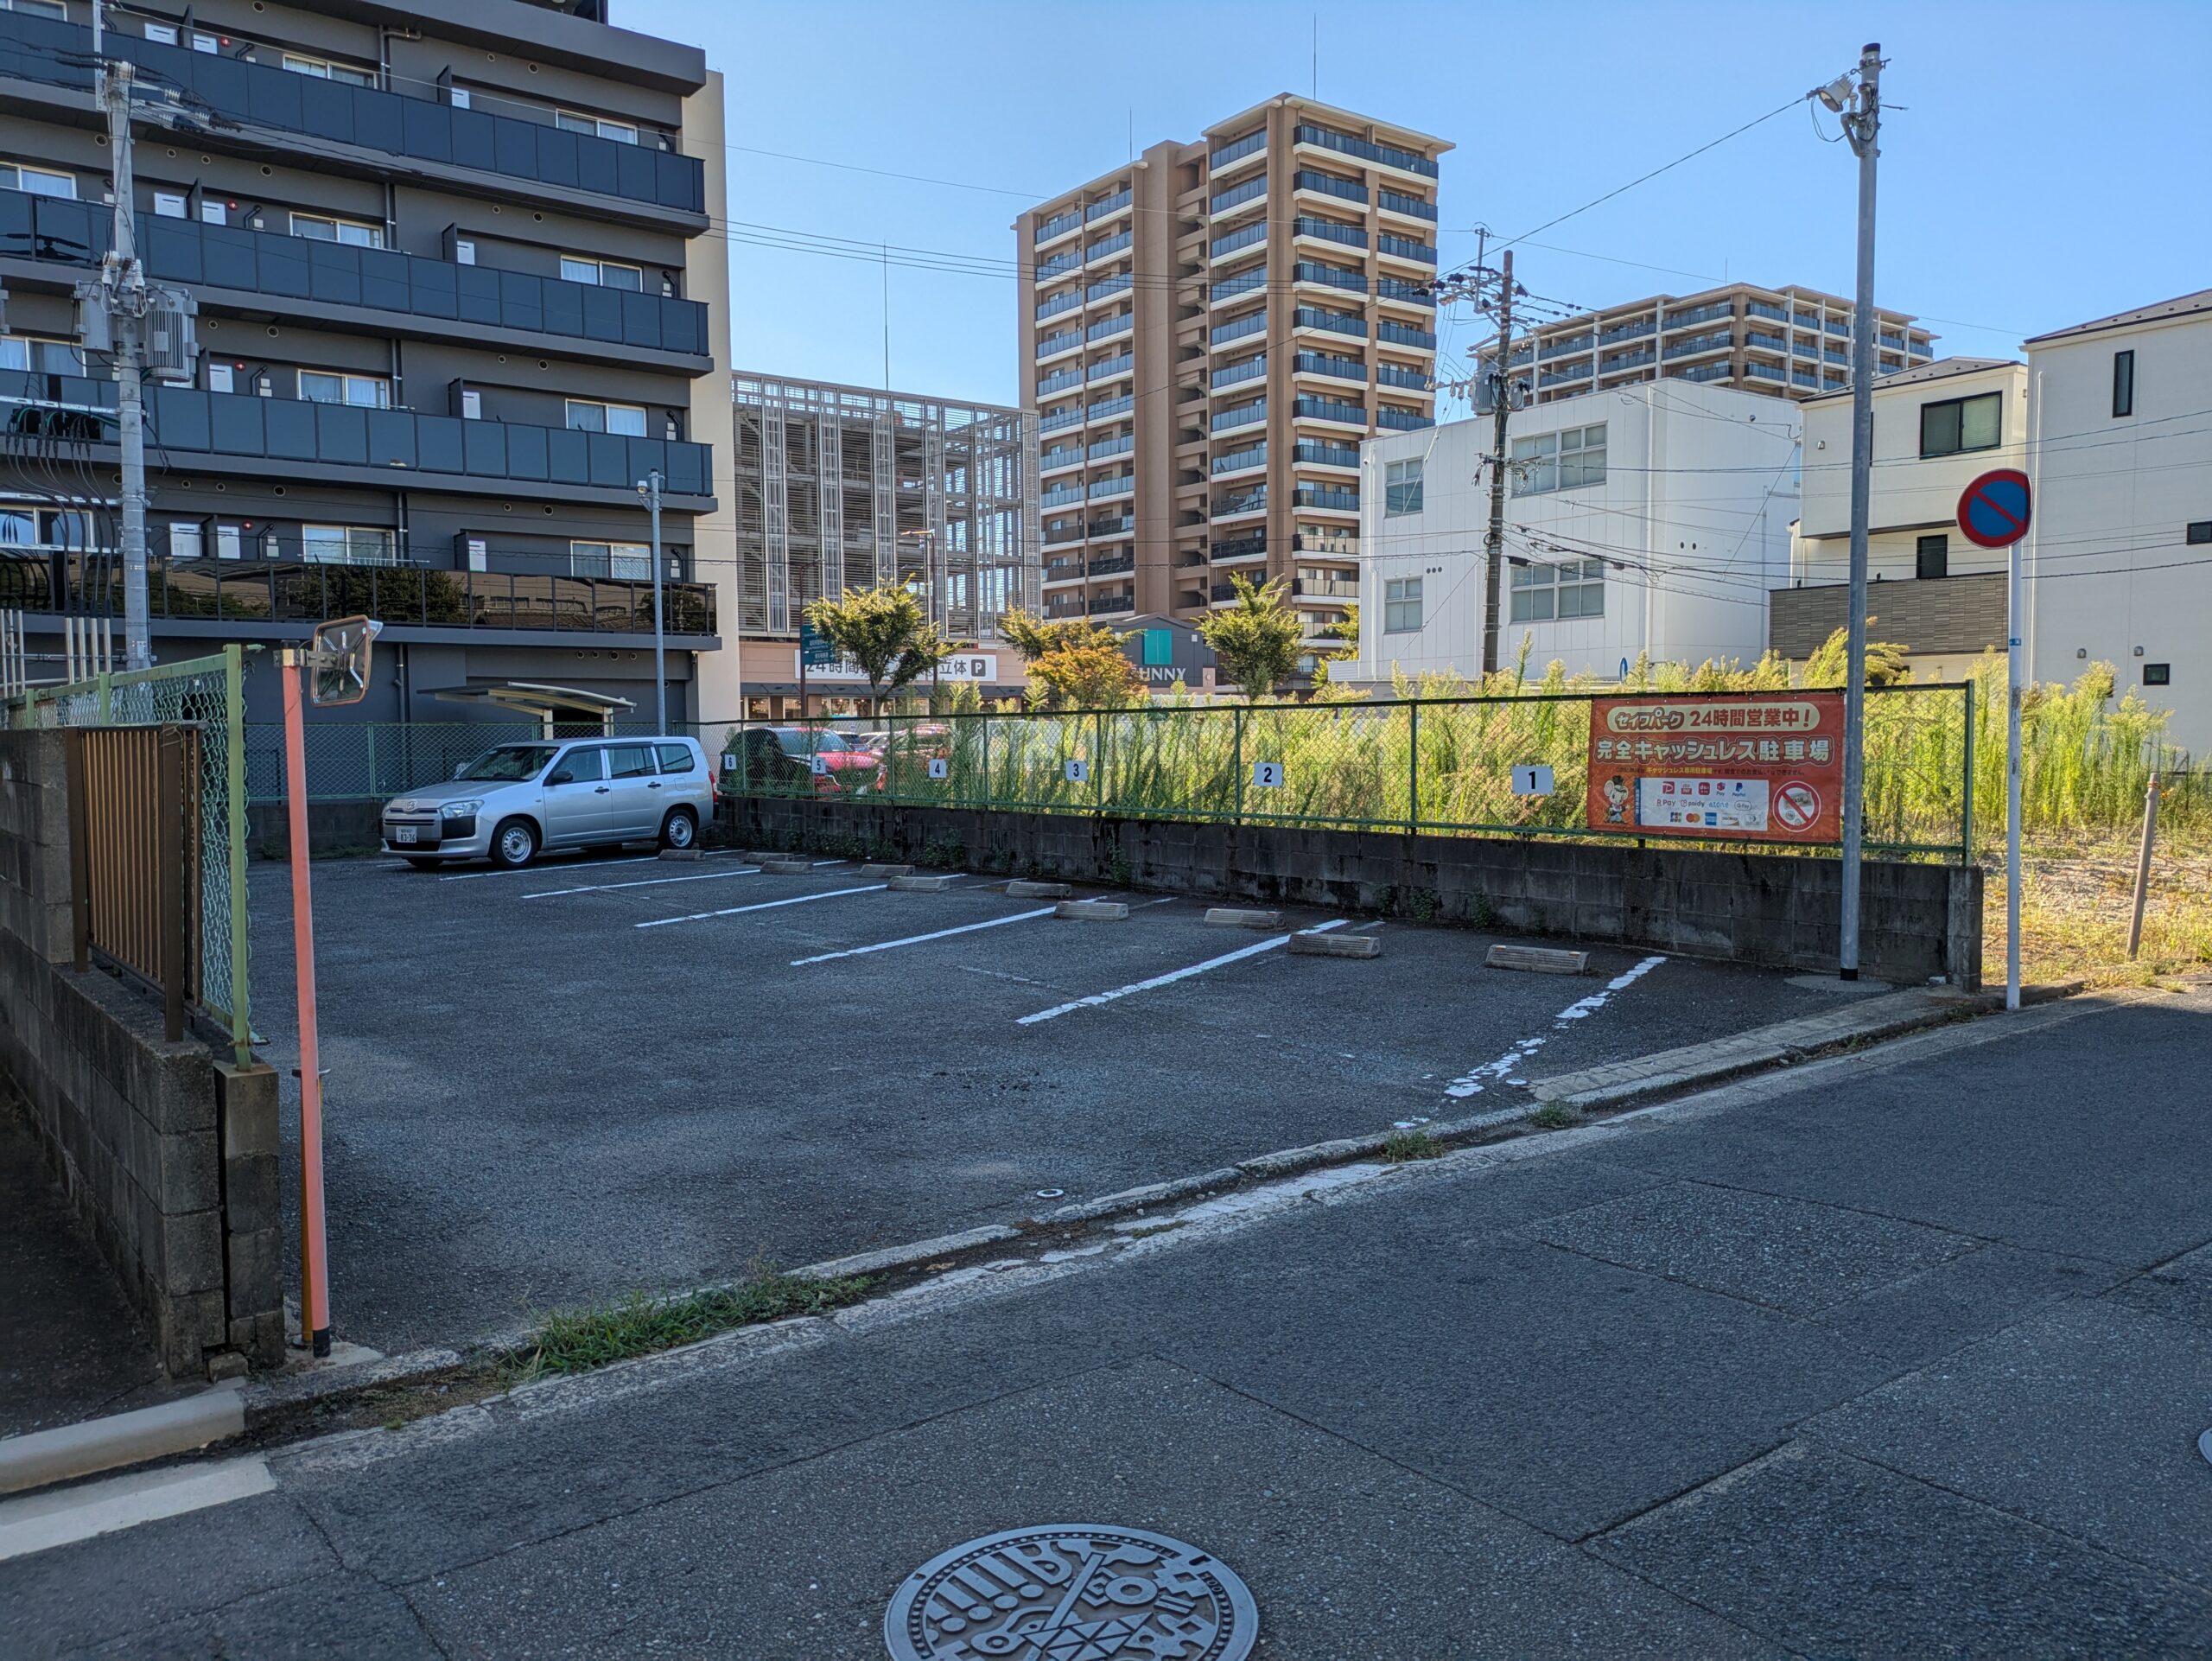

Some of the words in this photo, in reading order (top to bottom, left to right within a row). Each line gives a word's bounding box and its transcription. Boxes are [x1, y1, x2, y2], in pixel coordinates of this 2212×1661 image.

[1616, 707, 1683, 729] セイワパーク
[1596, 738, 1830, 763] 完全キャッシュレス駐車場
[817, 760, 821, 771] 5
[935, 763, 940, 774] 4
[1073, 763, 1079, 777] 3
[1264, 767, 1272, 782] 2
[1529, 771, 1535, 789] 1
